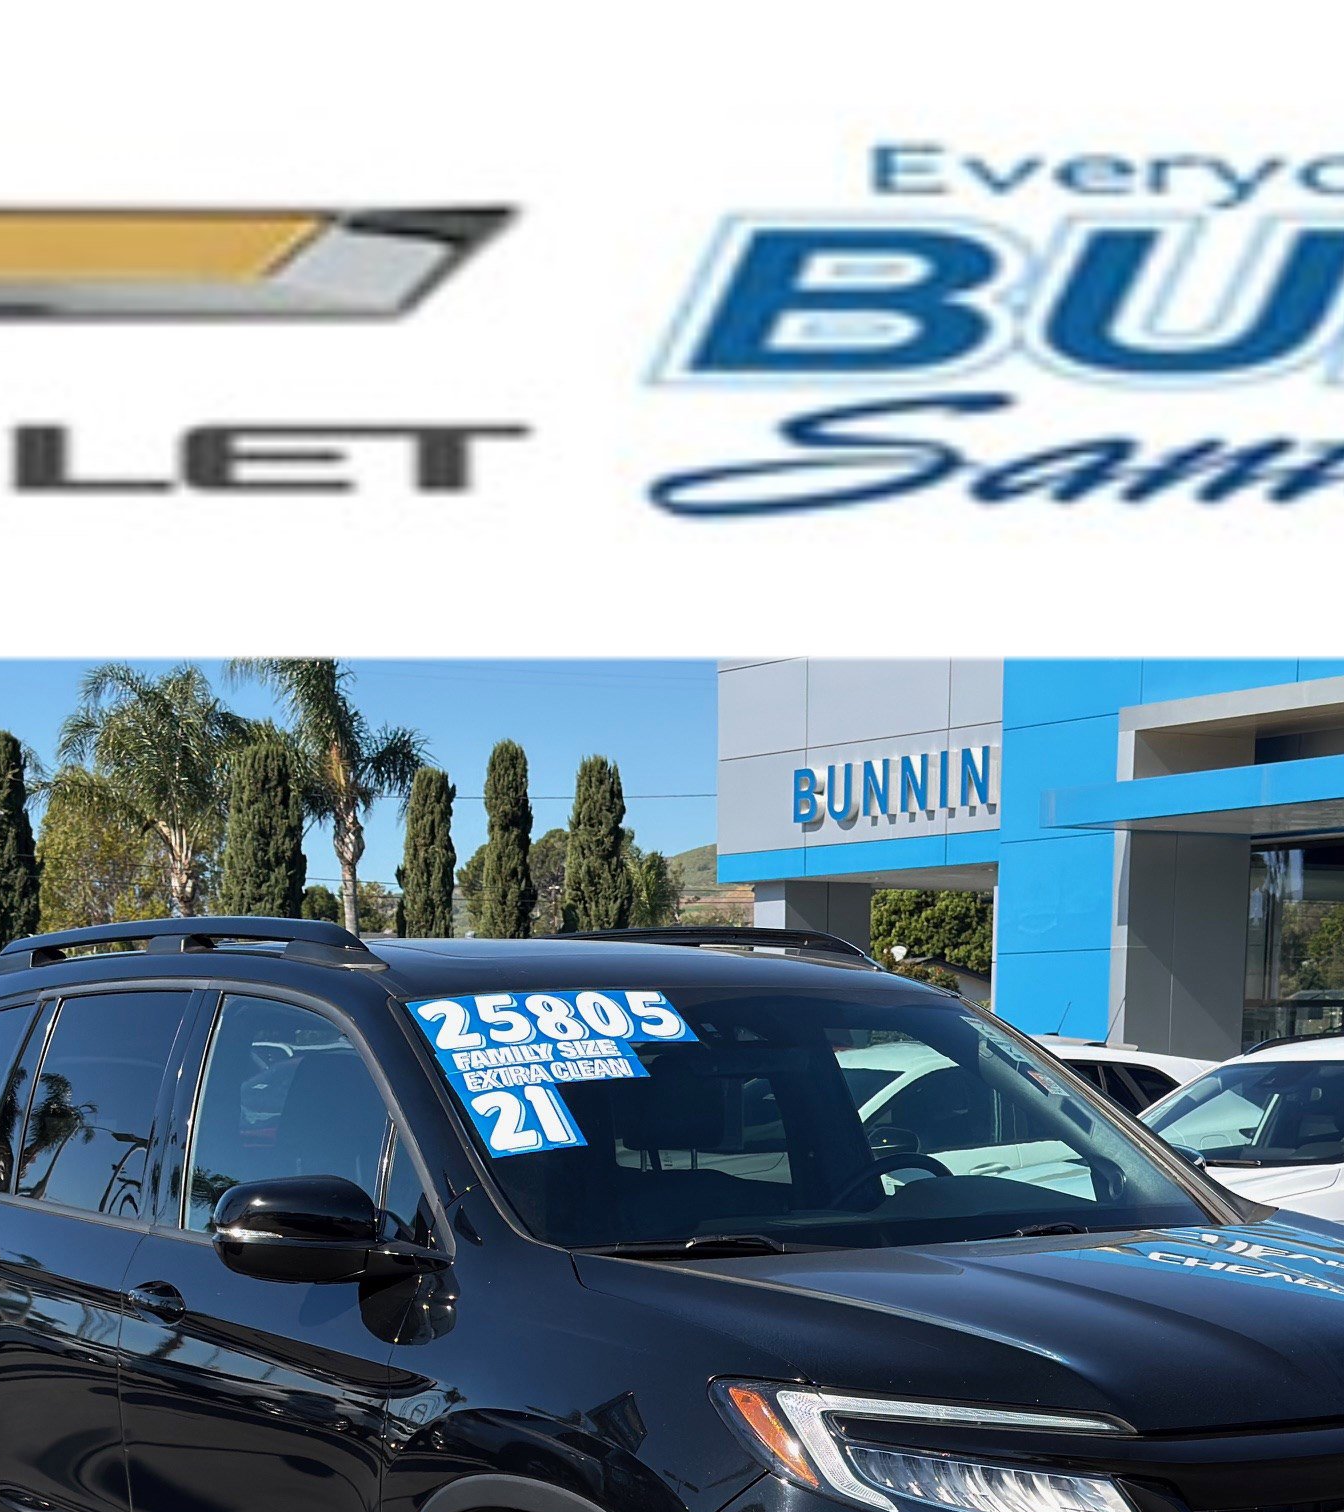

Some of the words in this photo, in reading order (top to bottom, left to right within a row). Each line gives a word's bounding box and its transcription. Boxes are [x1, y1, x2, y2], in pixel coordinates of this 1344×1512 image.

[792, 745, 992, 824] BUNNIN
[417, 990, 685, 1051] 25805
[451, 1042, 554, 1072] FAMILY
[556, 1038, 622, 1059] SIZE
[462, 1064, 555, 1093] EXTRA
[549, 1057, 633, 1081] CLEAN
[470, 1085, 578, 1152] 21
